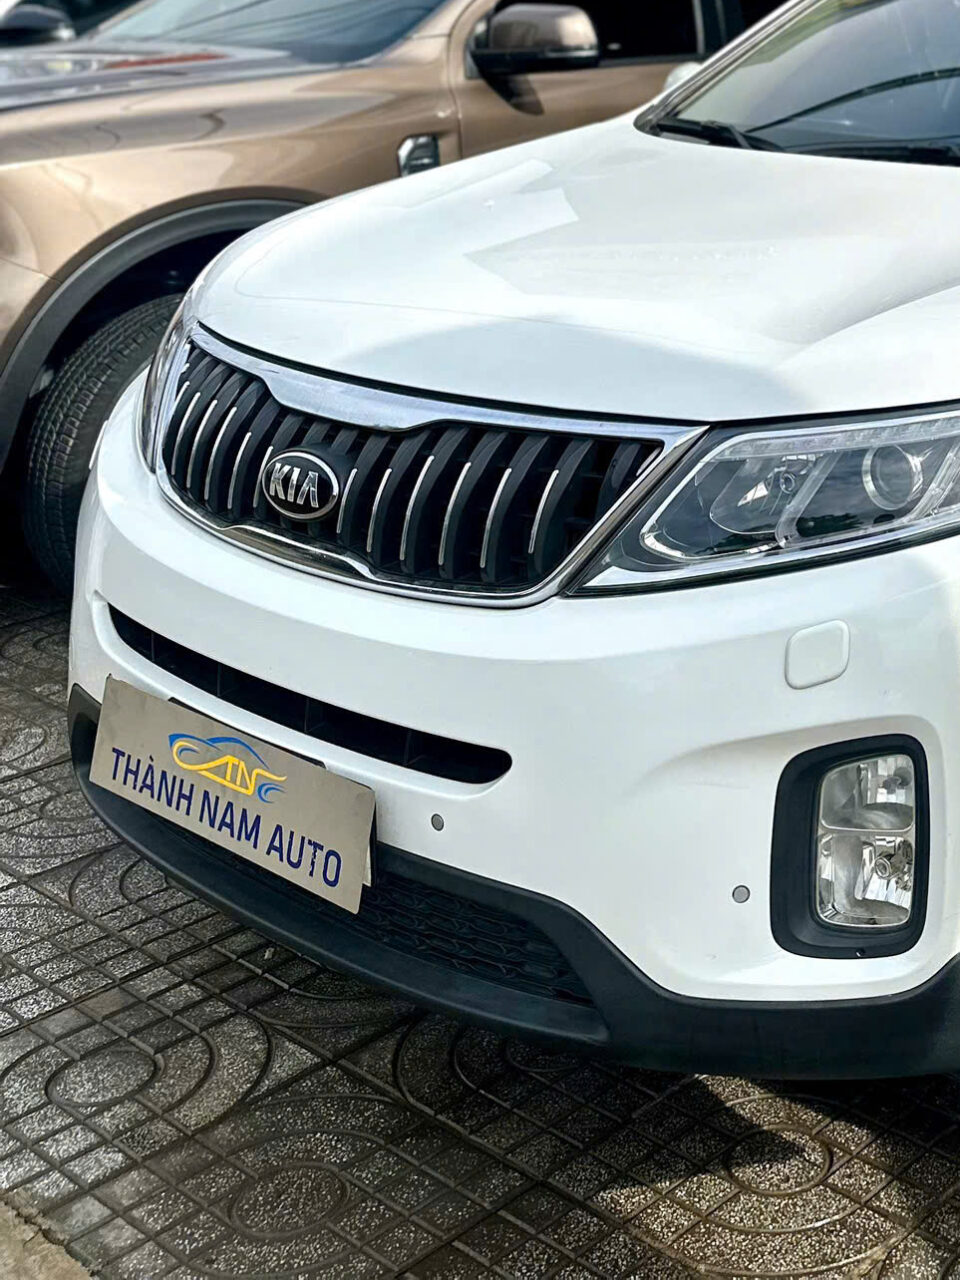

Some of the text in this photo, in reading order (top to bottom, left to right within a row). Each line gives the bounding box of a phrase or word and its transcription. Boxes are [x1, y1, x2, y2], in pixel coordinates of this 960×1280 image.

[269, 462, 319, 509] KIA
[111, 746, 342, 888] THÀNH NAM AUTO
